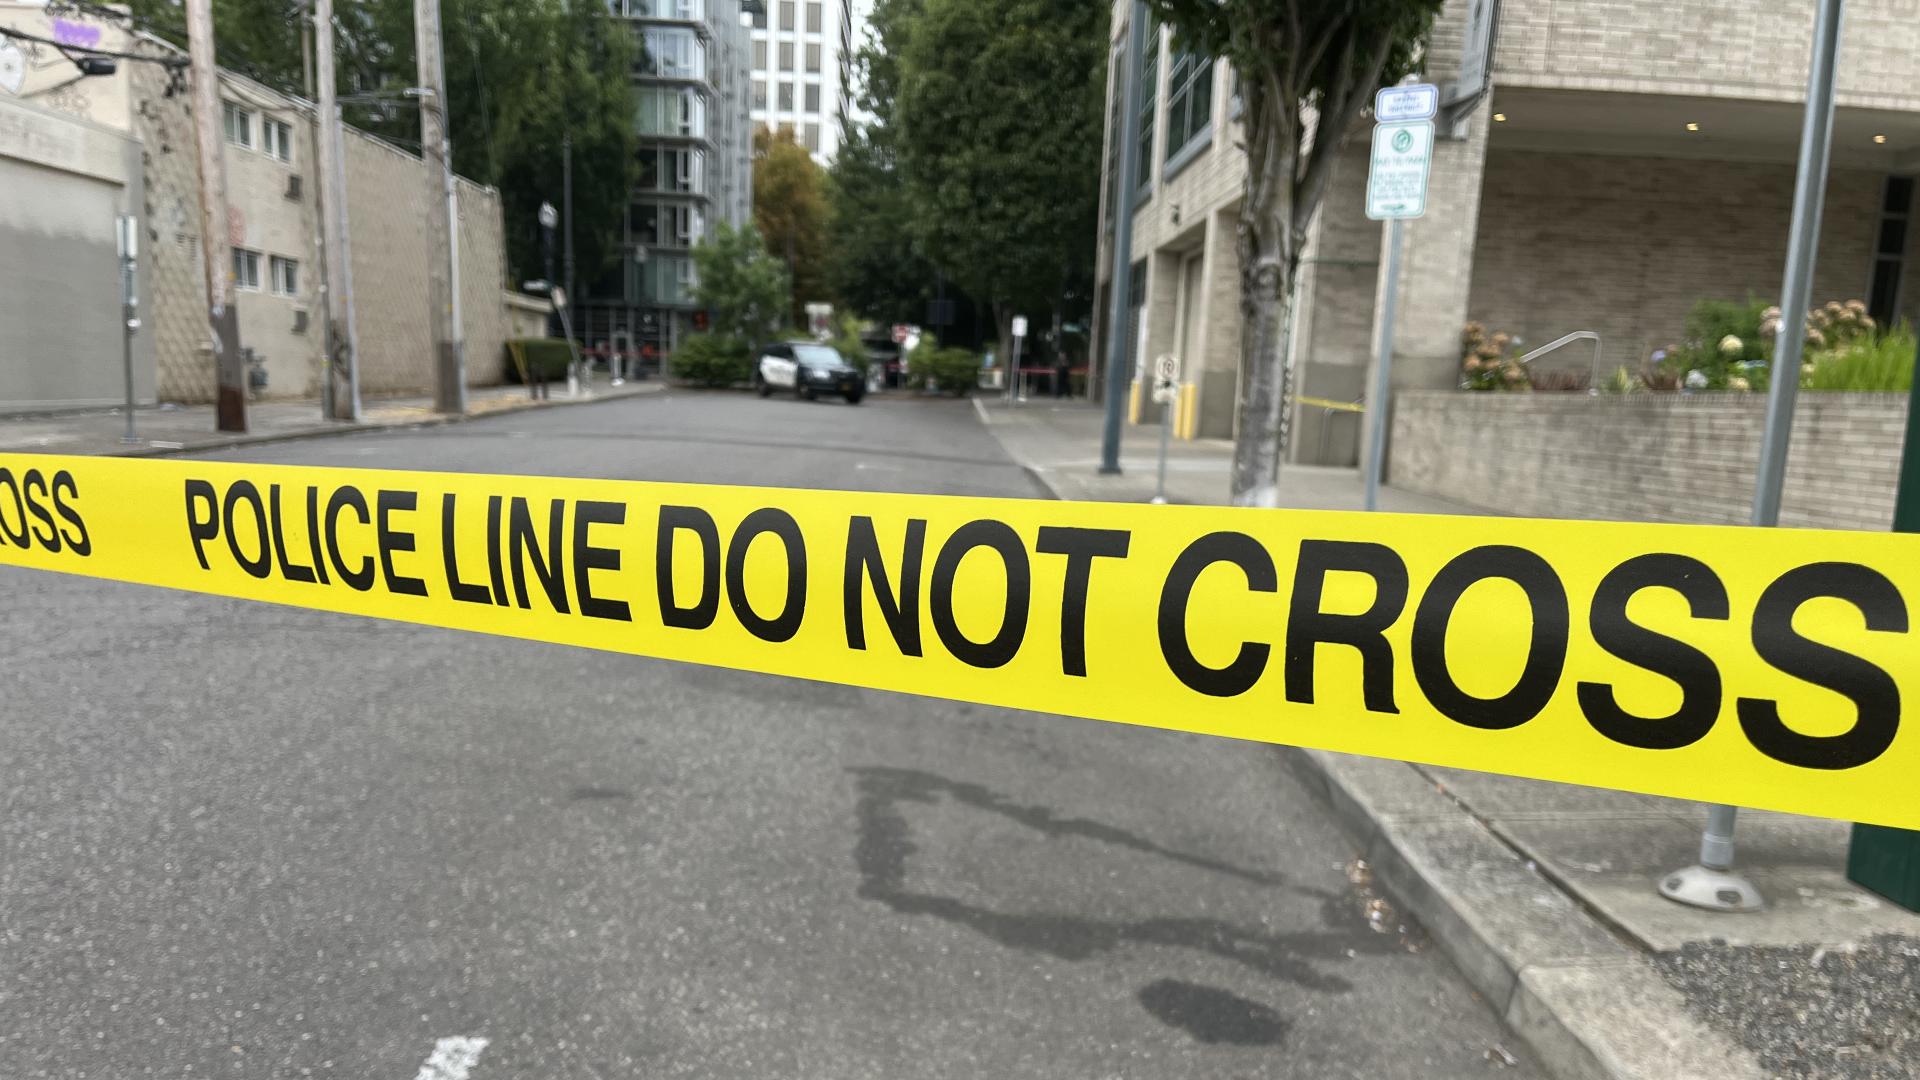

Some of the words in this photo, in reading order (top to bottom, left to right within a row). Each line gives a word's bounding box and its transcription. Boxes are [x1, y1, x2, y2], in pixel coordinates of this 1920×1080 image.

[0, 467, 92, 557] OSS
[185, 479, 429, 597] POLICE
[441, 493, 633, 622] LINE
[655, 504, 808, 643] DO
[843, 515, 1132, 678] NOT
[1157, 531, 1909, 771] CROSS
